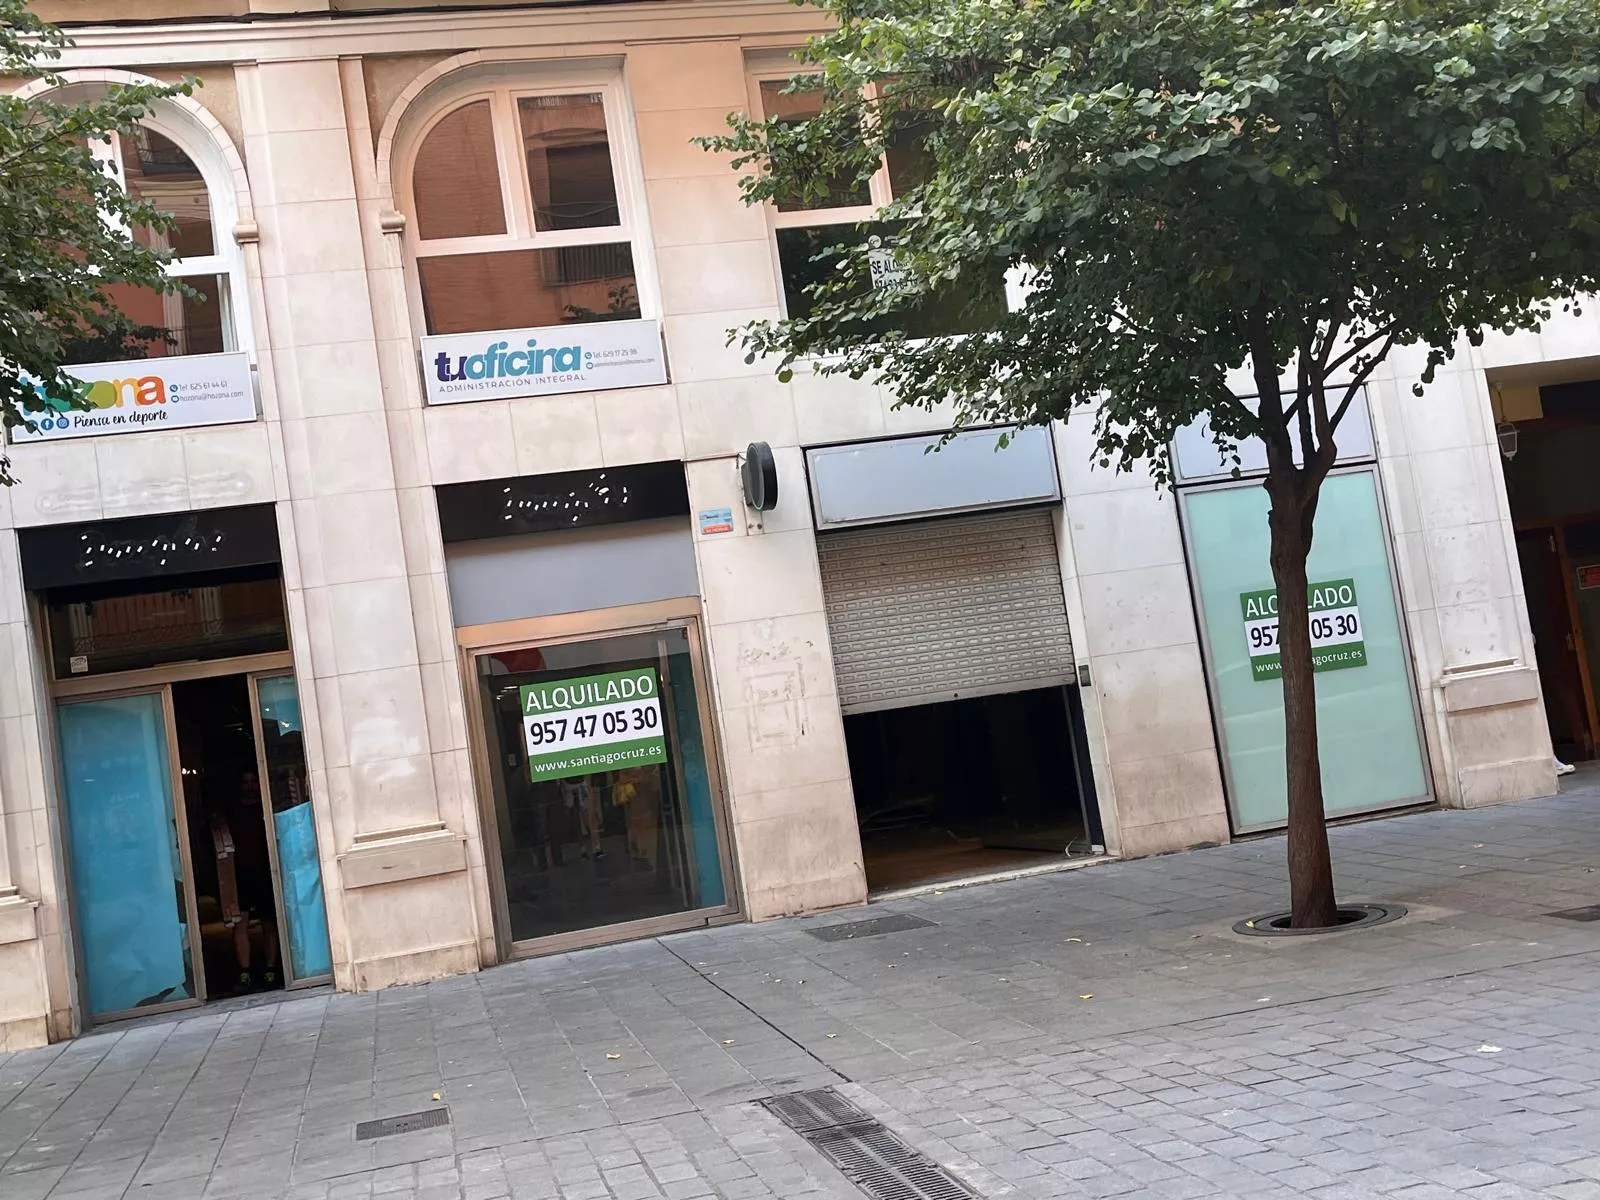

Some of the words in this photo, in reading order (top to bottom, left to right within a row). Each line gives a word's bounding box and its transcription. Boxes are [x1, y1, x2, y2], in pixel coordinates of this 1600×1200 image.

[872, 260, 883, 274] SE
[190, 382, 202, 391] 625
[203, 381, 210, 389] 61
[439, 378, 531, 393] ADMINISTRACIÓN
[535, 374, 587, 384] INTEGRAL
[74, 416, 110, 428] Piensa
[113, 415, 126, 424] en
[129, 410, 168, 425] deporte
[1311, 617, 1333, 639] 05
[1335, 613, 1358, 636] 30
[526, 675, 653, 712] ALQUILADO
[530, 719, 568, 745] 957
[573, 714, 597, 738] 47
[603, 710, 628, 735] 05
[632, 706, 658, 730] 30
[535, 745, 661, 773] www.santiagocruz.es
